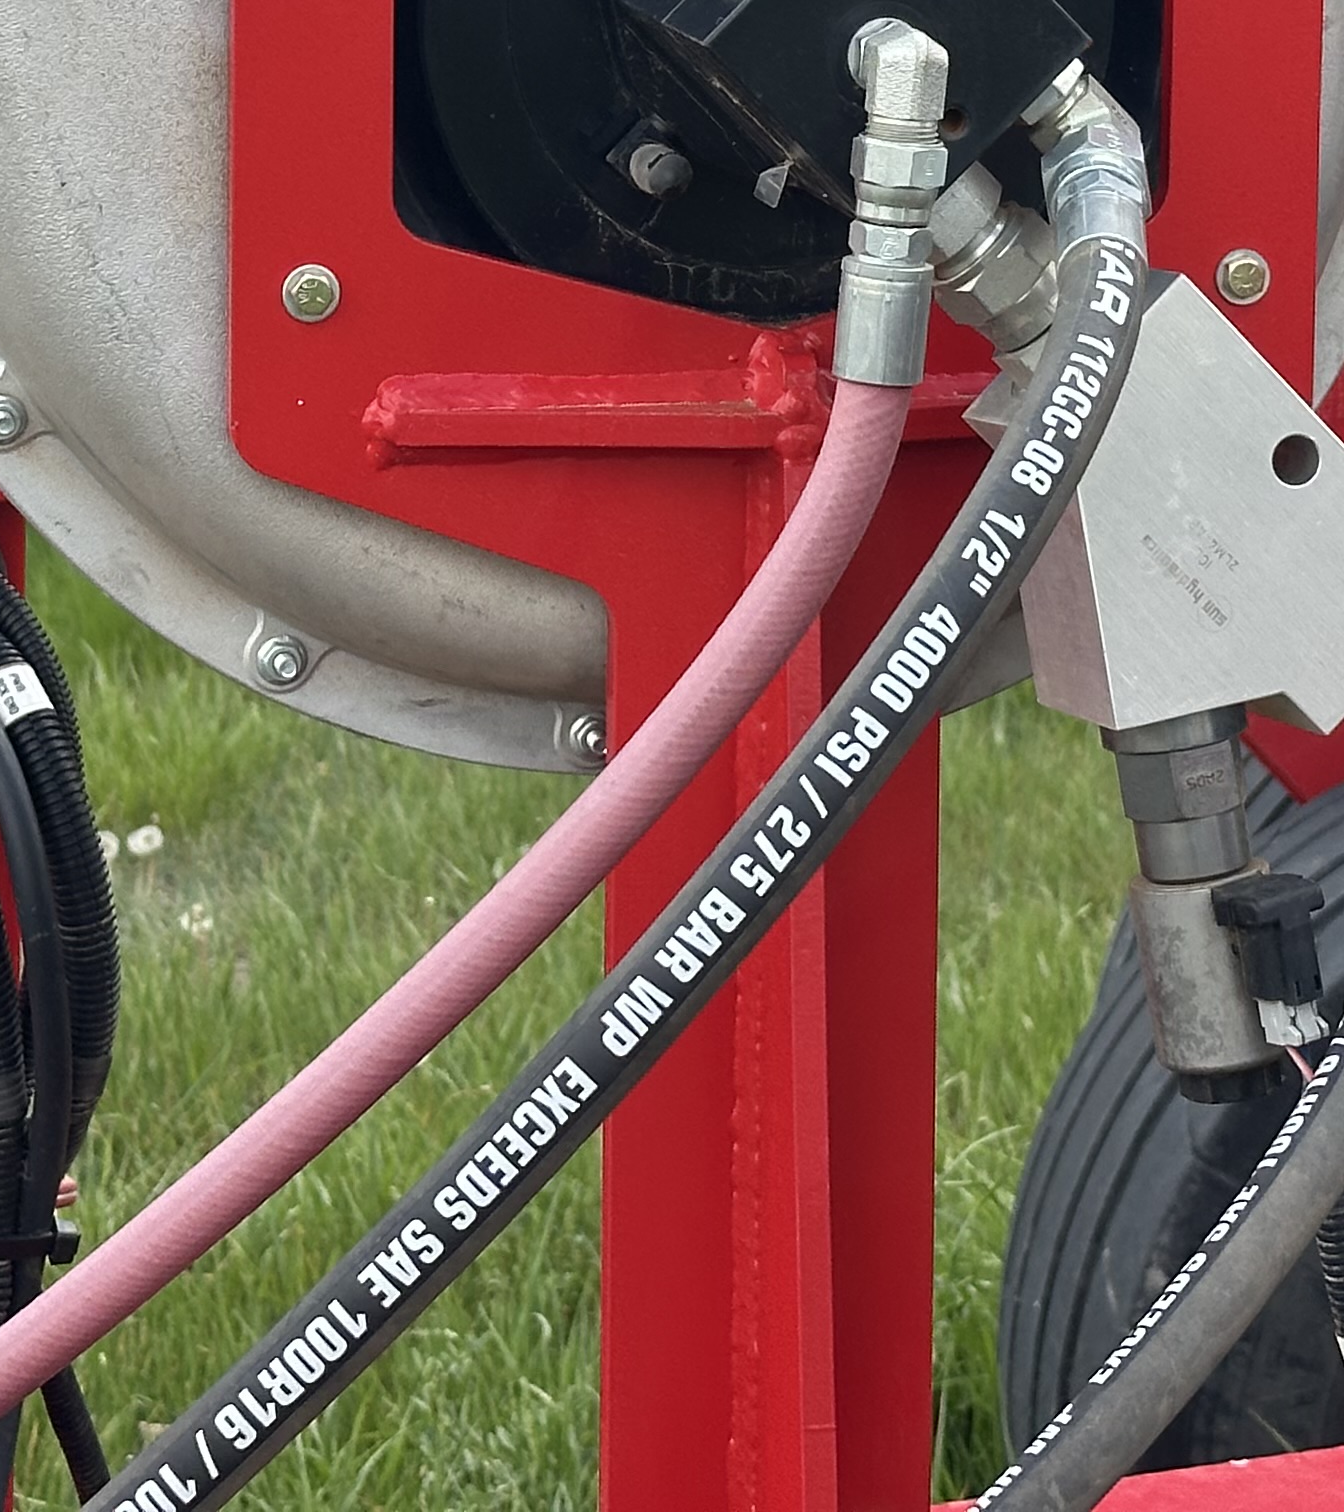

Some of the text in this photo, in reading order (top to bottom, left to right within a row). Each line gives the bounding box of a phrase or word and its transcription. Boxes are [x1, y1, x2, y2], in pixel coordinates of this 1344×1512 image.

[1012, 333, 1115, 497] 112CC-08
[961, 509, 1027, 597] 1/2"
[870, 603, 961, 713] 4000
[813, 706, 890, 788] PSI
[729, 804, 811, 897] 275
[655, 887, 747, 983] BAR
[601, 975, 674, 1057] WP
[433, 1056, 598, 1231] EXCEEDS
[356, 1219, 444, 1308] SAE
[214, 1299, 369, 1450] 100R16
